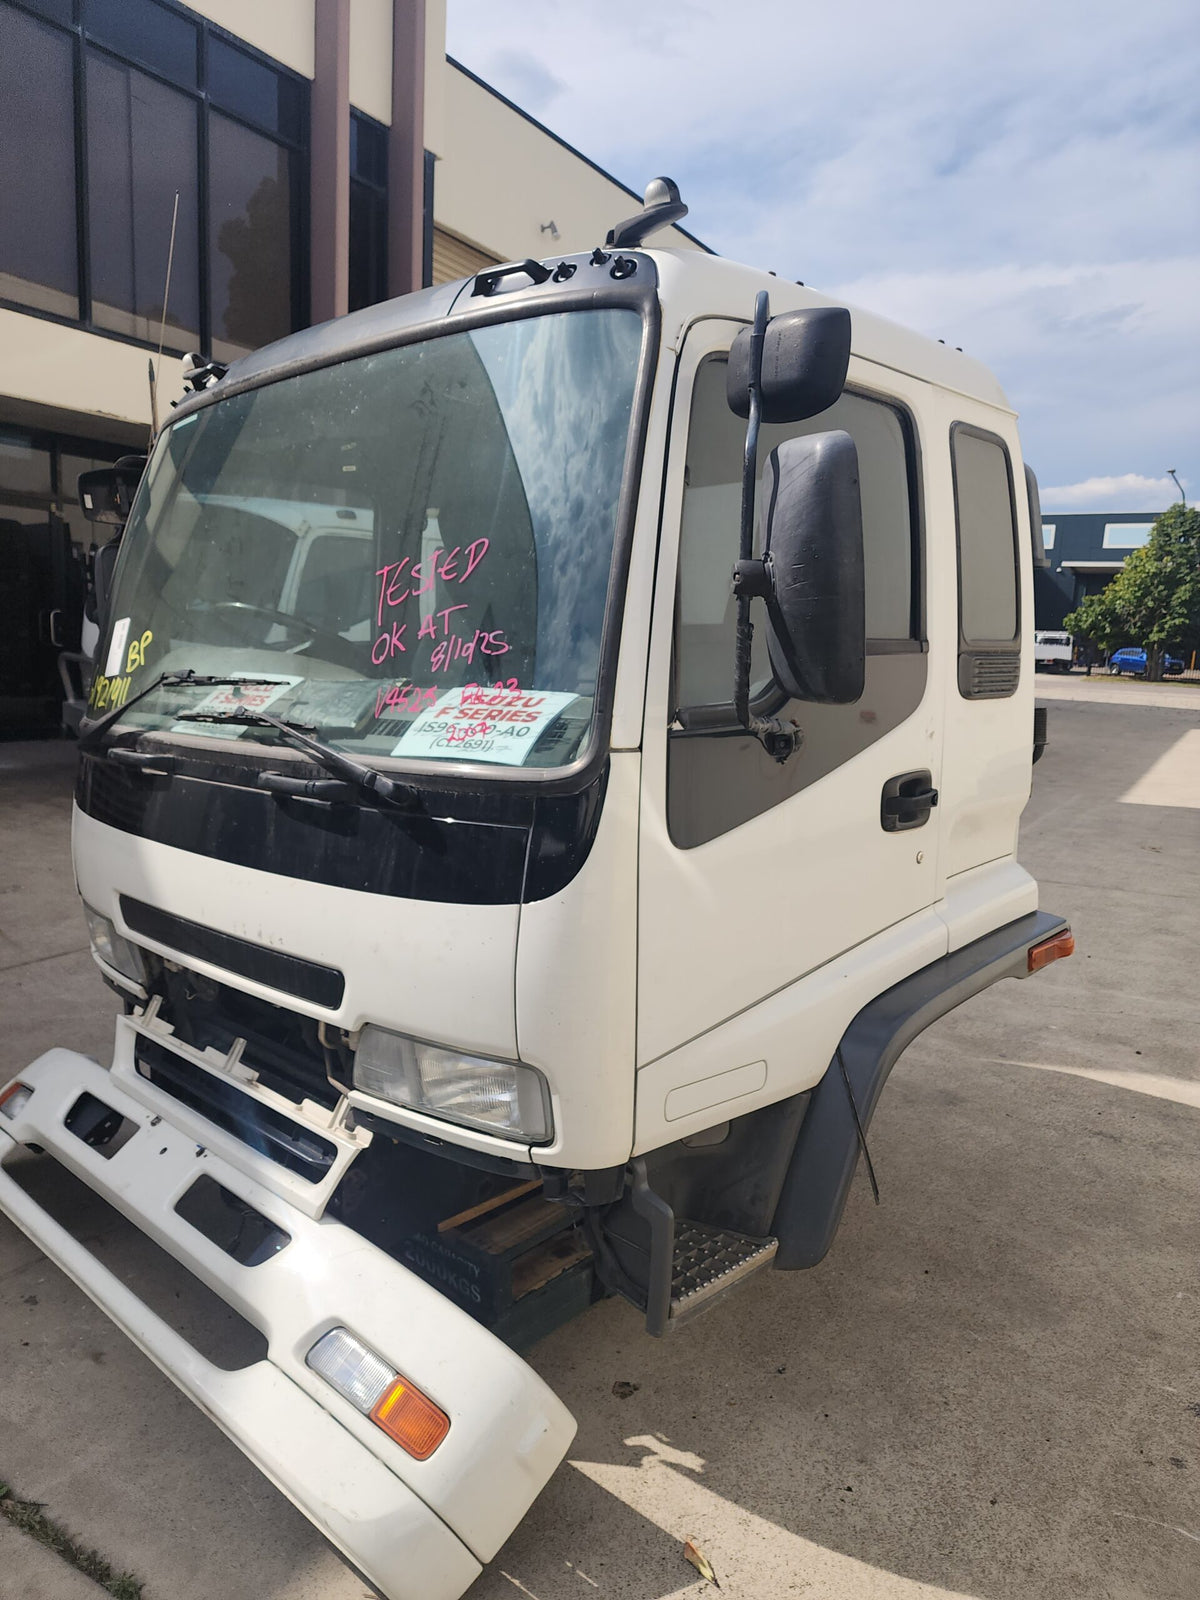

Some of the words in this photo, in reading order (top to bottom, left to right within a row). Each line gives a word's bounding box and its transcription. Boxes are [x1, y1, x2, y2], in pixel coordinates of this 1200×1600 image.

[376, 537, 490, 627] TESTED
[126, 630, 153, 673] BP
[371, 621, 406, 665] OK
[417, 603, 468, 640] AT
[434, 707, 452, 719] F
[452, 707, 543, 723] SERIES
